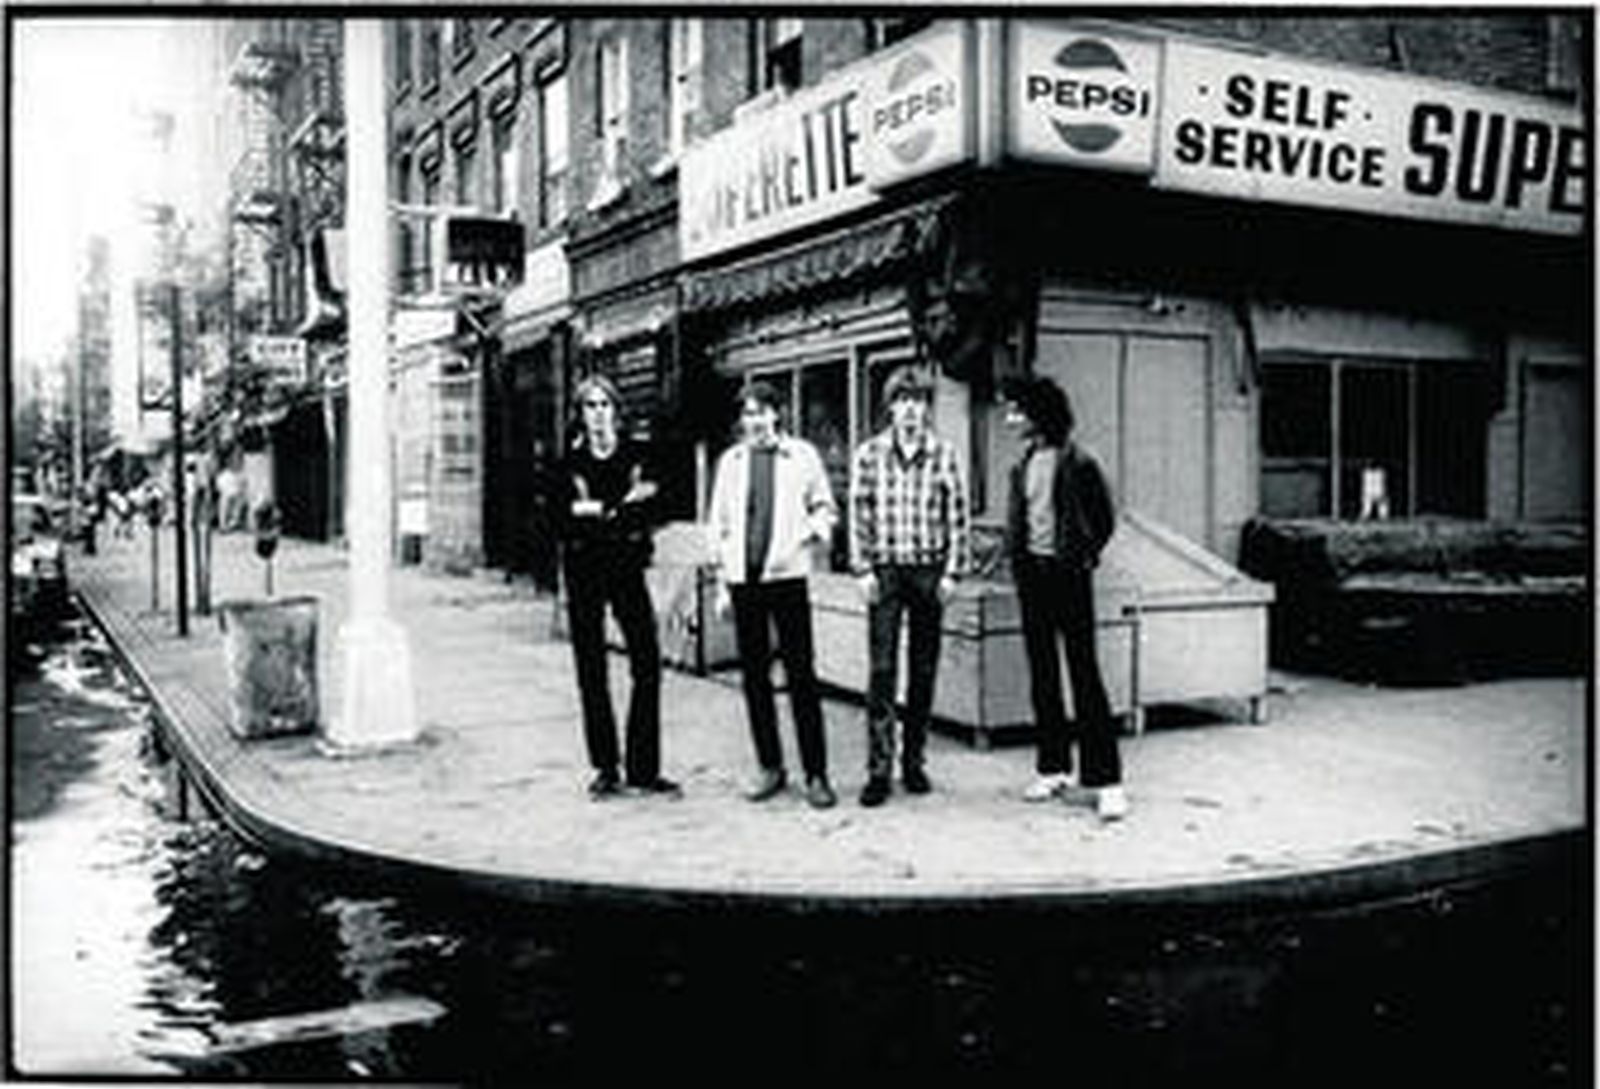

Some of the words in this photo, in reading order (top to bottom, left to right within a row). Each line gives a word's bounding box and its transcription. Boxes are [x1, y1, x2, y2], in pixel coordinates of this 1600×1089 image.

[873, 78, 956, 135] PEPSI
[1027, 76, 1149, 118] PEPSI
[1225, 74, 1351, 129] SELF
[1174, 120, 1386, 187] SERVICE
[1404, 103, 1586, 213] SUPE
